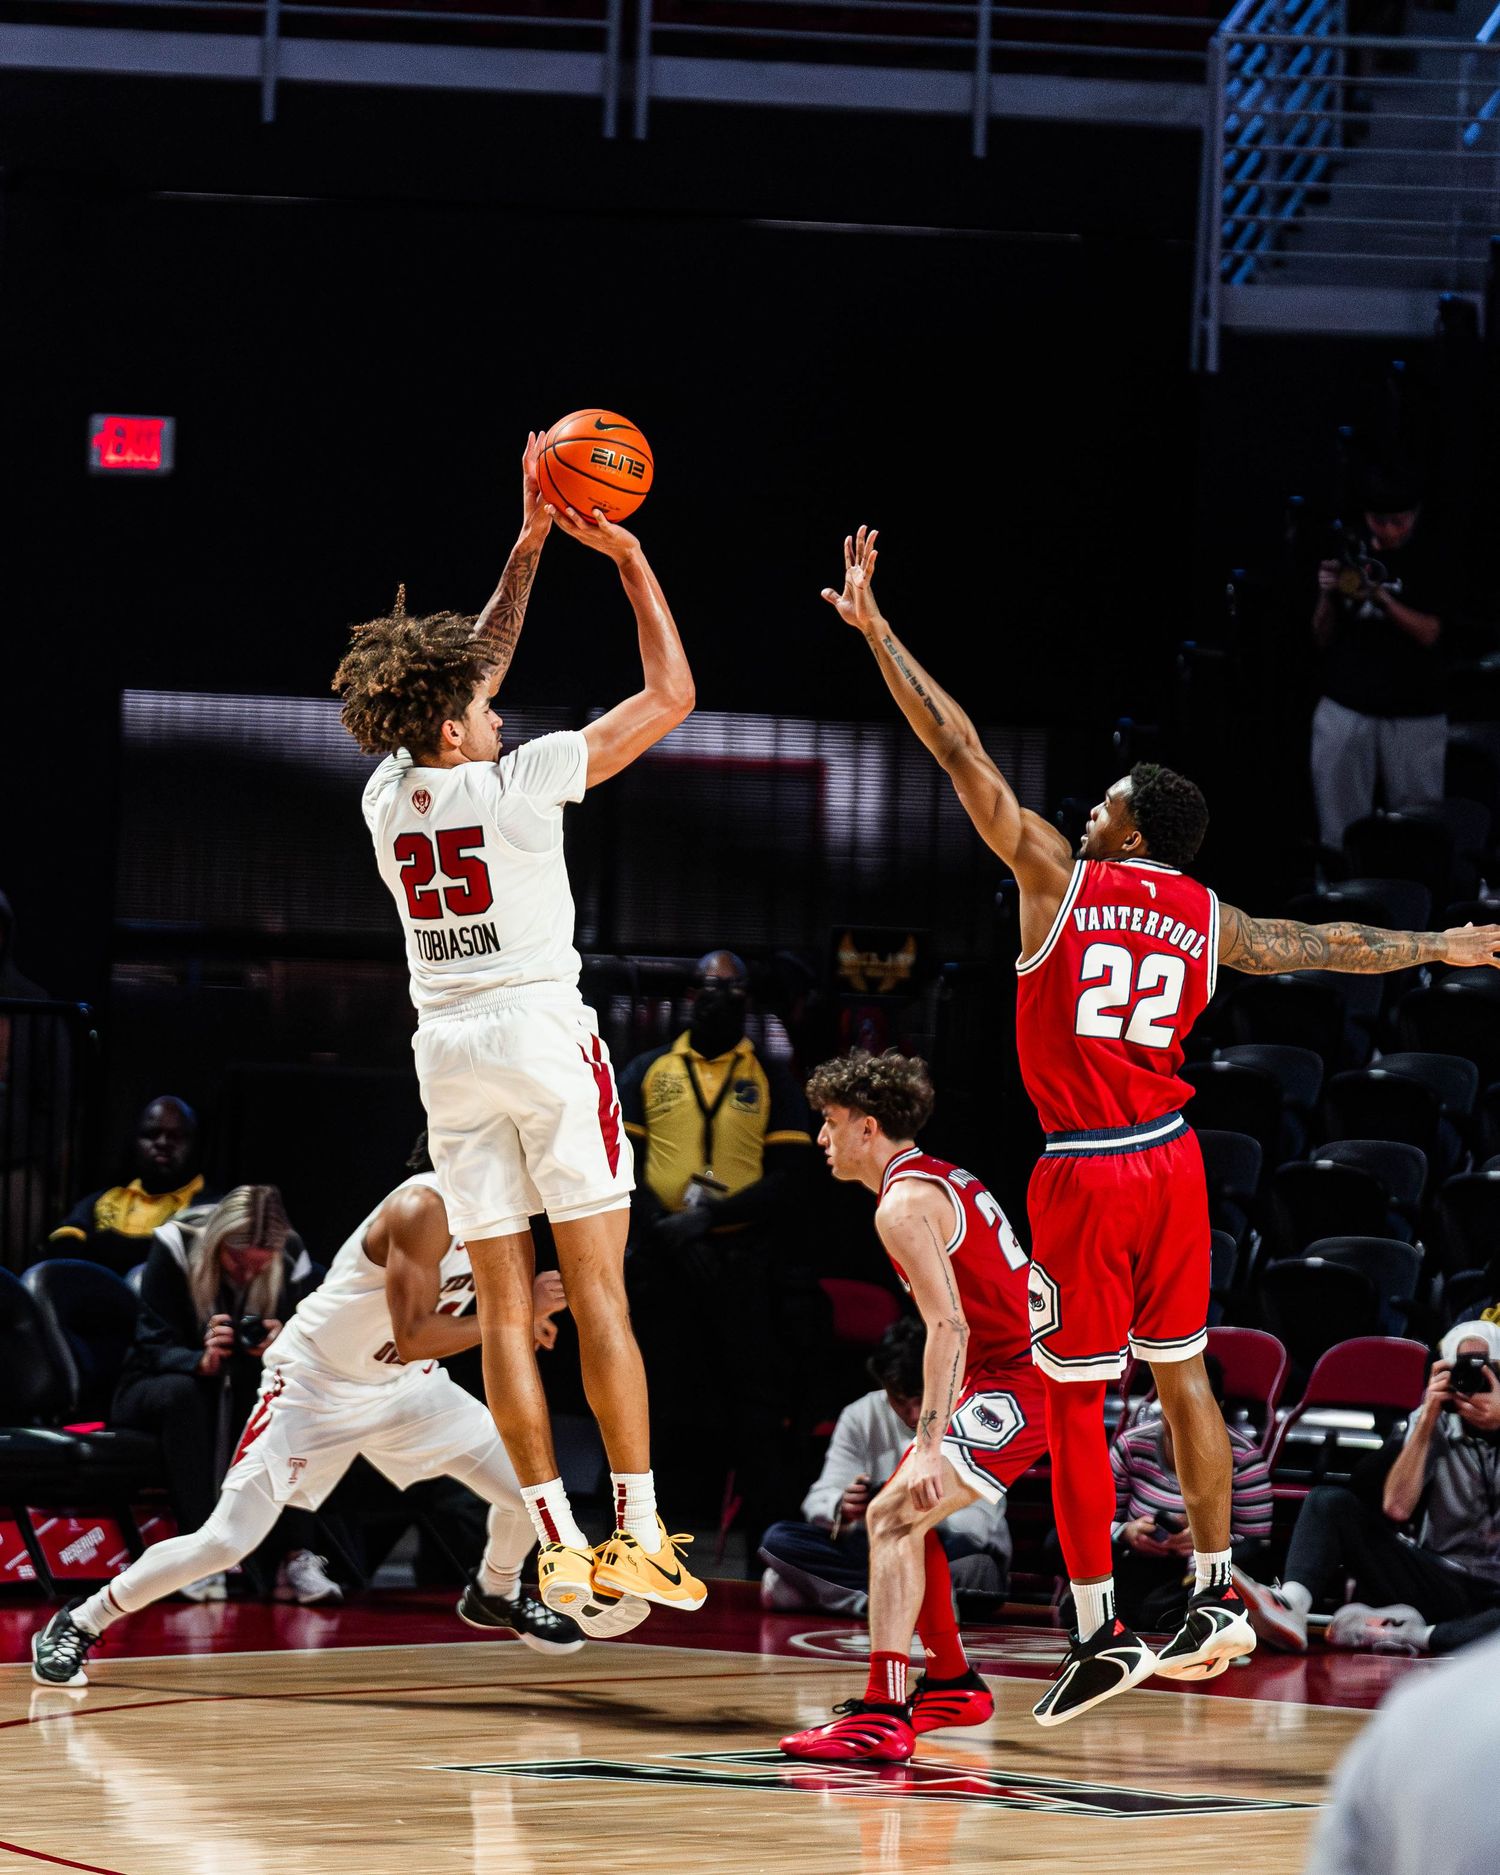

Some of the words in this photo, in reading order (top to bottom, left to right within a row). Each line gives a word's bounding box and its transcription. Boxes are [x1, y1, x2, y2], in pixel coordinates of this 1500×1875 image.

[590, 447, 646, 480] ELITE
[393, 825, 494, 920] 25
[413, 921, 501, 961] TOBIASON
[1073, 905, 1207, 960] VANTERPOOL
[1075, 941, 1187, 1050] 22
